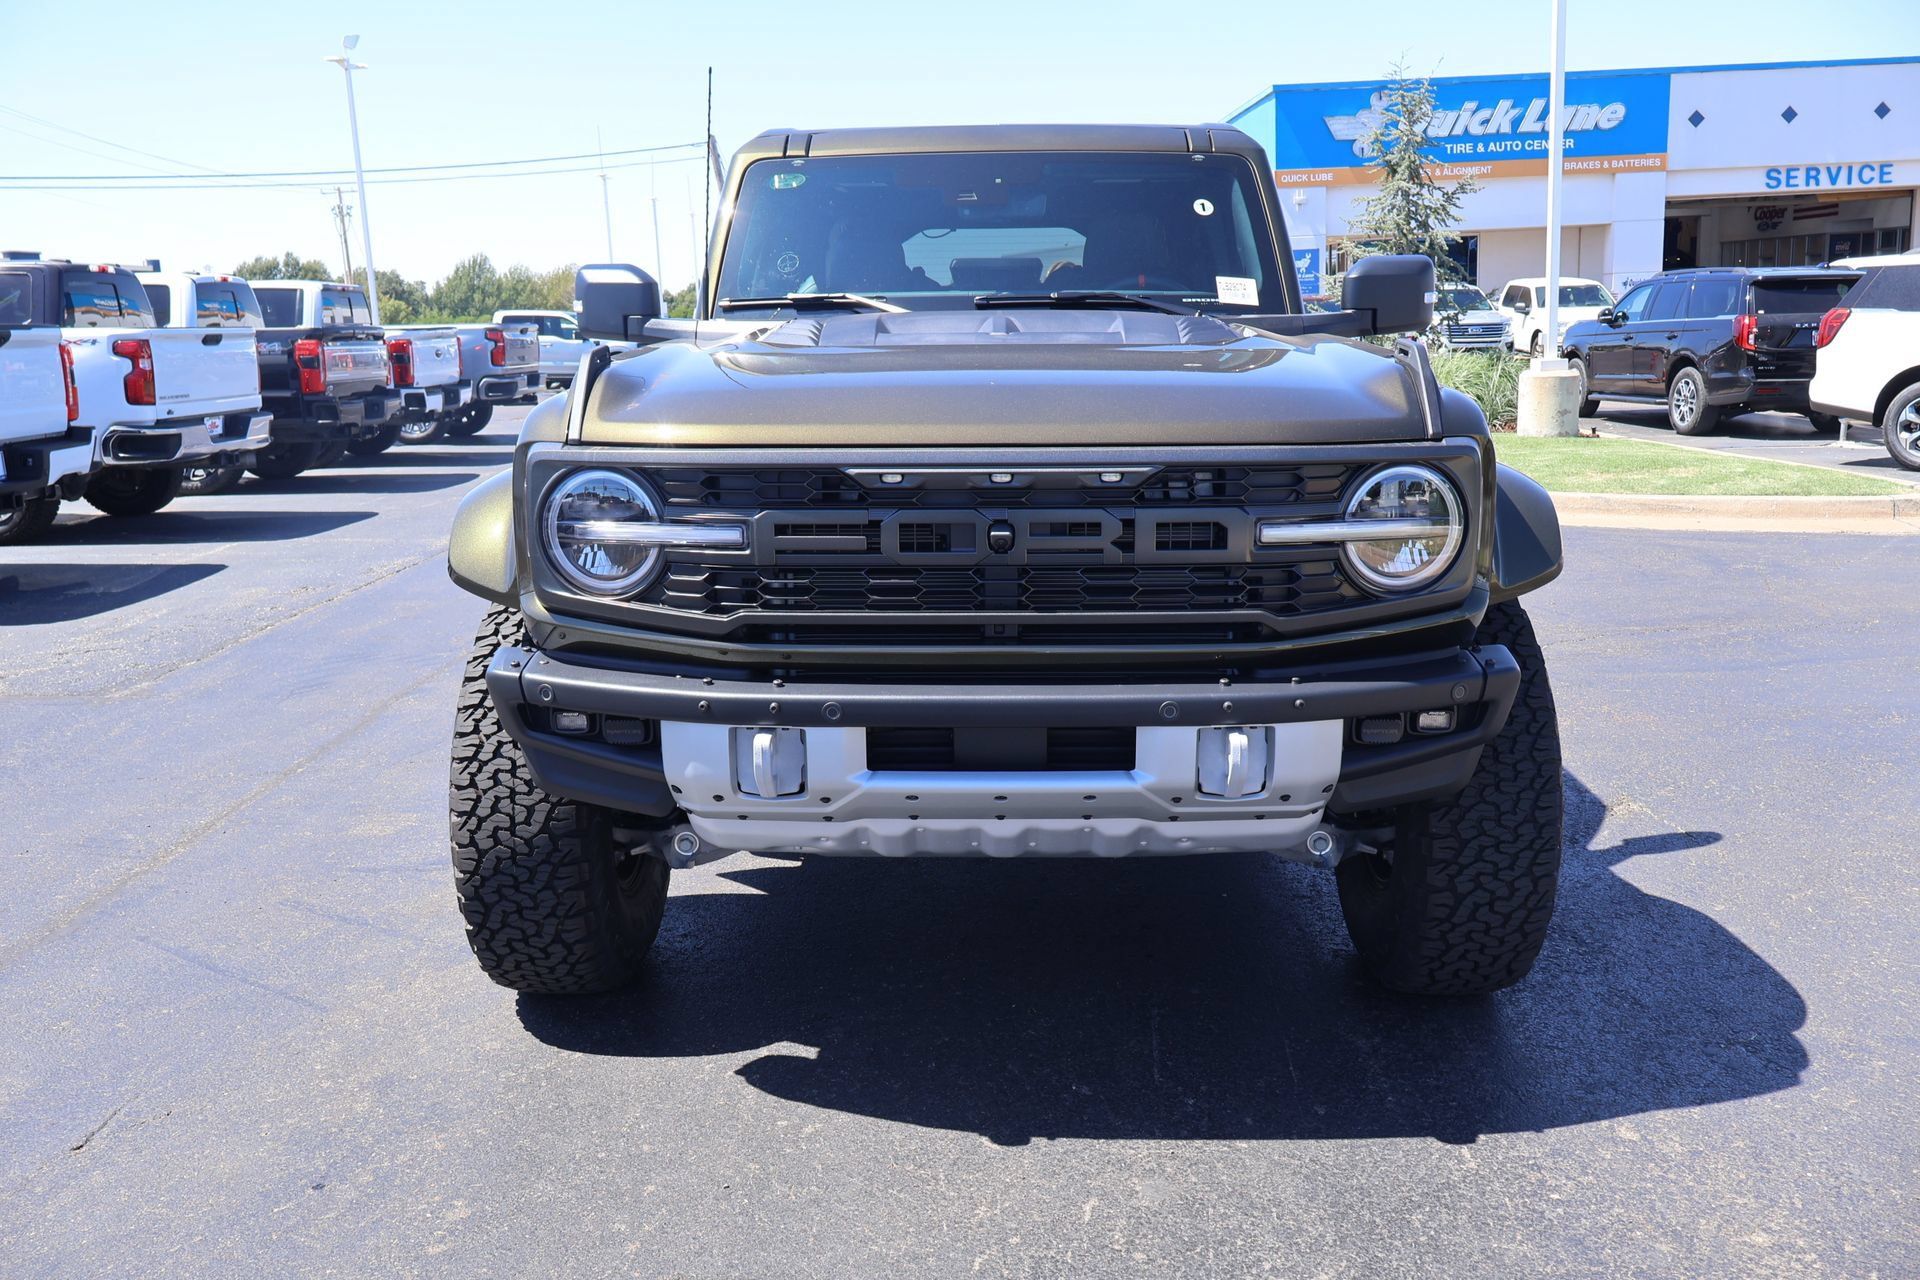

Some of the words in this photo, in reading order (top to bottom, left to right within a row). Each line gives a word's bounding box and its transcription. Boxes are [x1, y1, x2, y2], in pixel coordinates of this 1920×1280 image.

[1445, 142, 1474, 154] TIRE
[1476, 142, 1485, 153] &
[1487, 140, 1522, 153] AUTO
[1524, 138, 1574, 151] CENER
[1564, 160, 1600, 170] BRAKES
[1603, 160, 1609, 168] &
[1612, 158, 1661, 168] BATTERIES
[1442, 166, 1492, 176] ALIGNMENT
[1765, 163, 1893, 189] SERVICE
[1281, 174, 1309, 183] QUICK
[1311, 173, 1333, 182] LUBE
[1199, 202, 1206, 212] 1
[755, 508, 1250, 565] FORD
